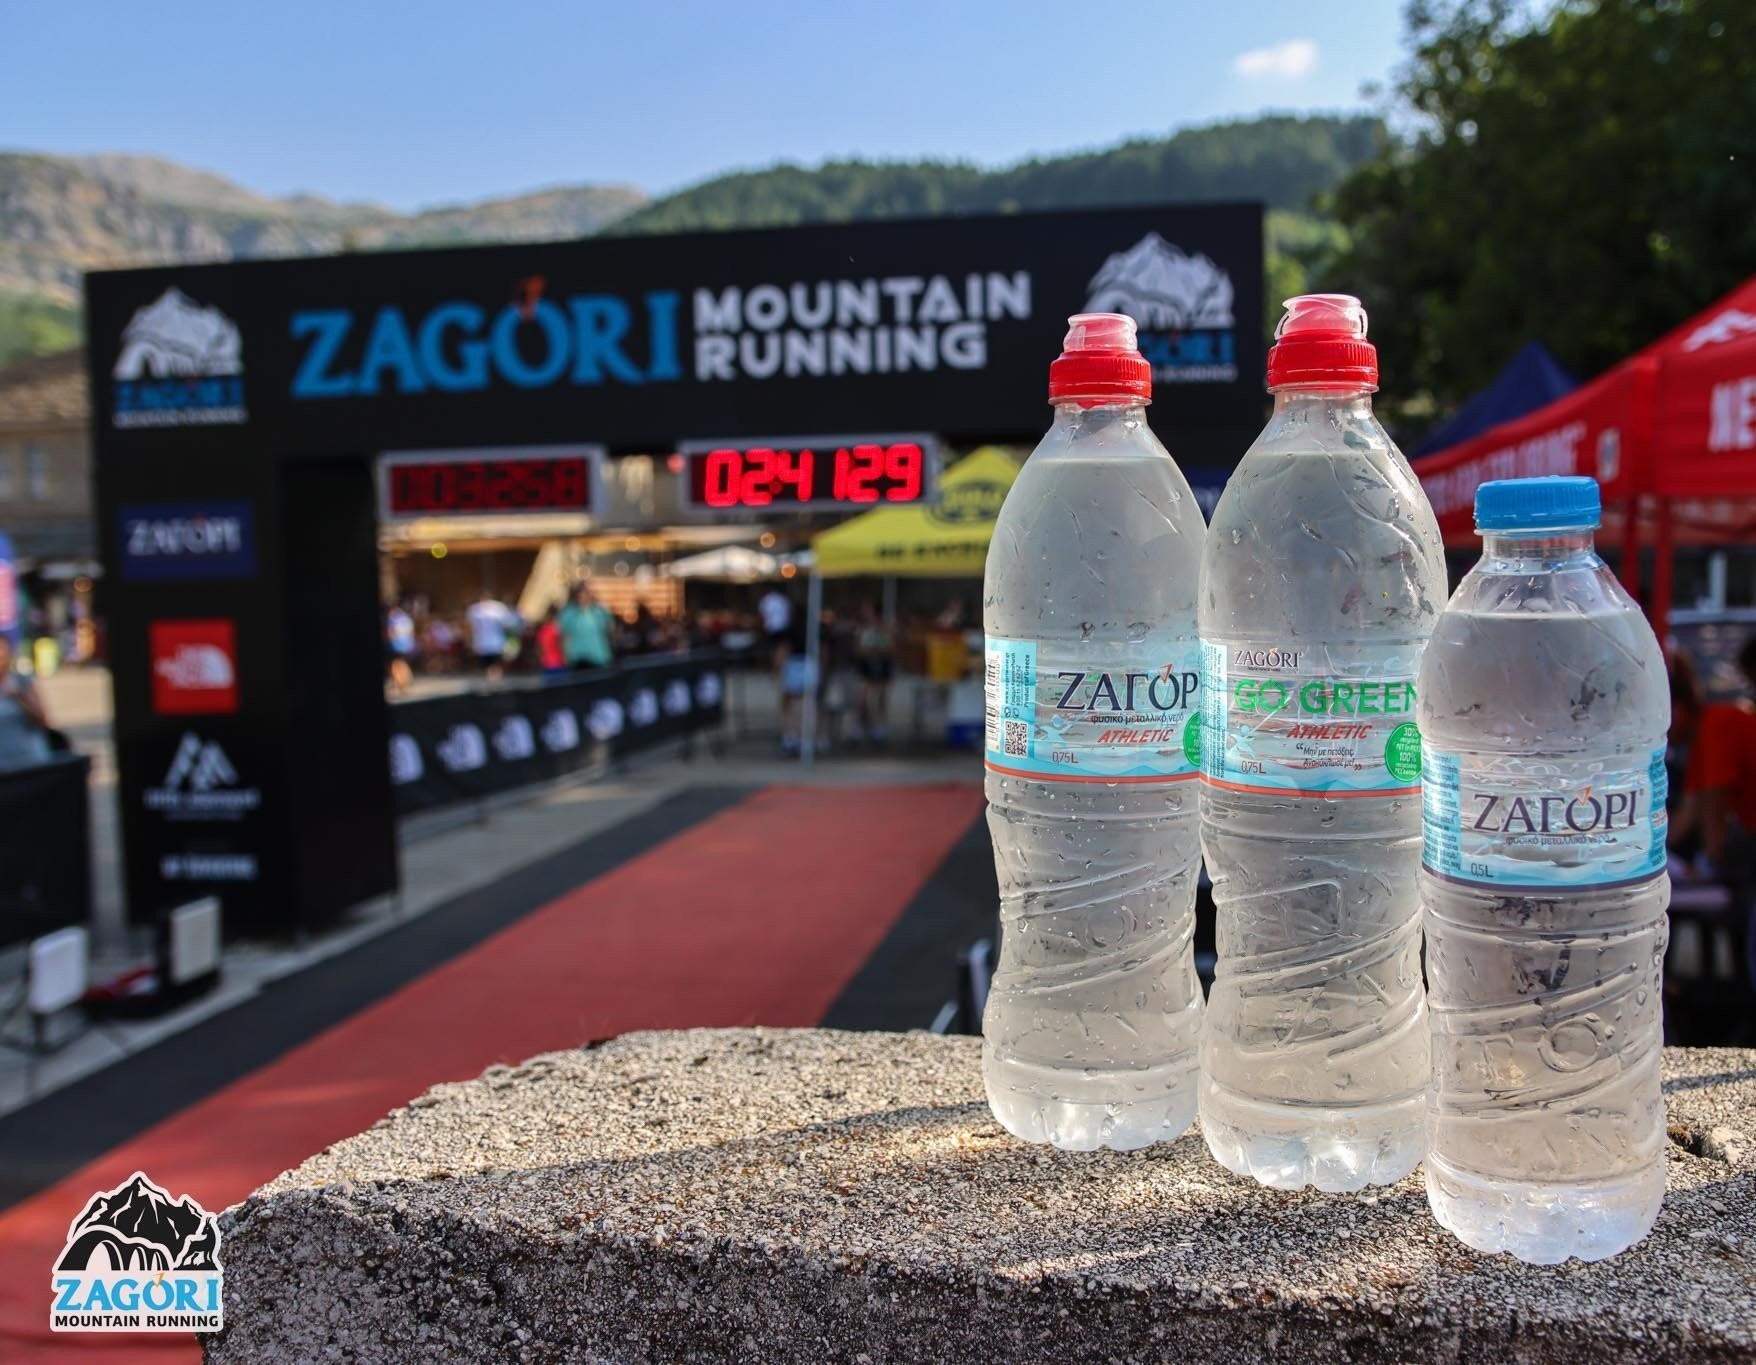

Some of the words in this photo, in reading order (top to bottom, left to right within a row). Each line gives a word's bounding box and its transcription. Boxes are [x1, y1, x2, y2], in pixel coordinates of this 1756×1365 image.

[694, 270, 1032, 333] MOUNTAIN
[695, 322, 988, 381] RUNNING
[1056, 666, 1200, 711] ΖΑΓΟΡ
[1234, 678, 1287, 712] GO
[1097, 729, 1174, 743] ATHLETIC
[1287, 724, 1373, 740] ATHLETIC
